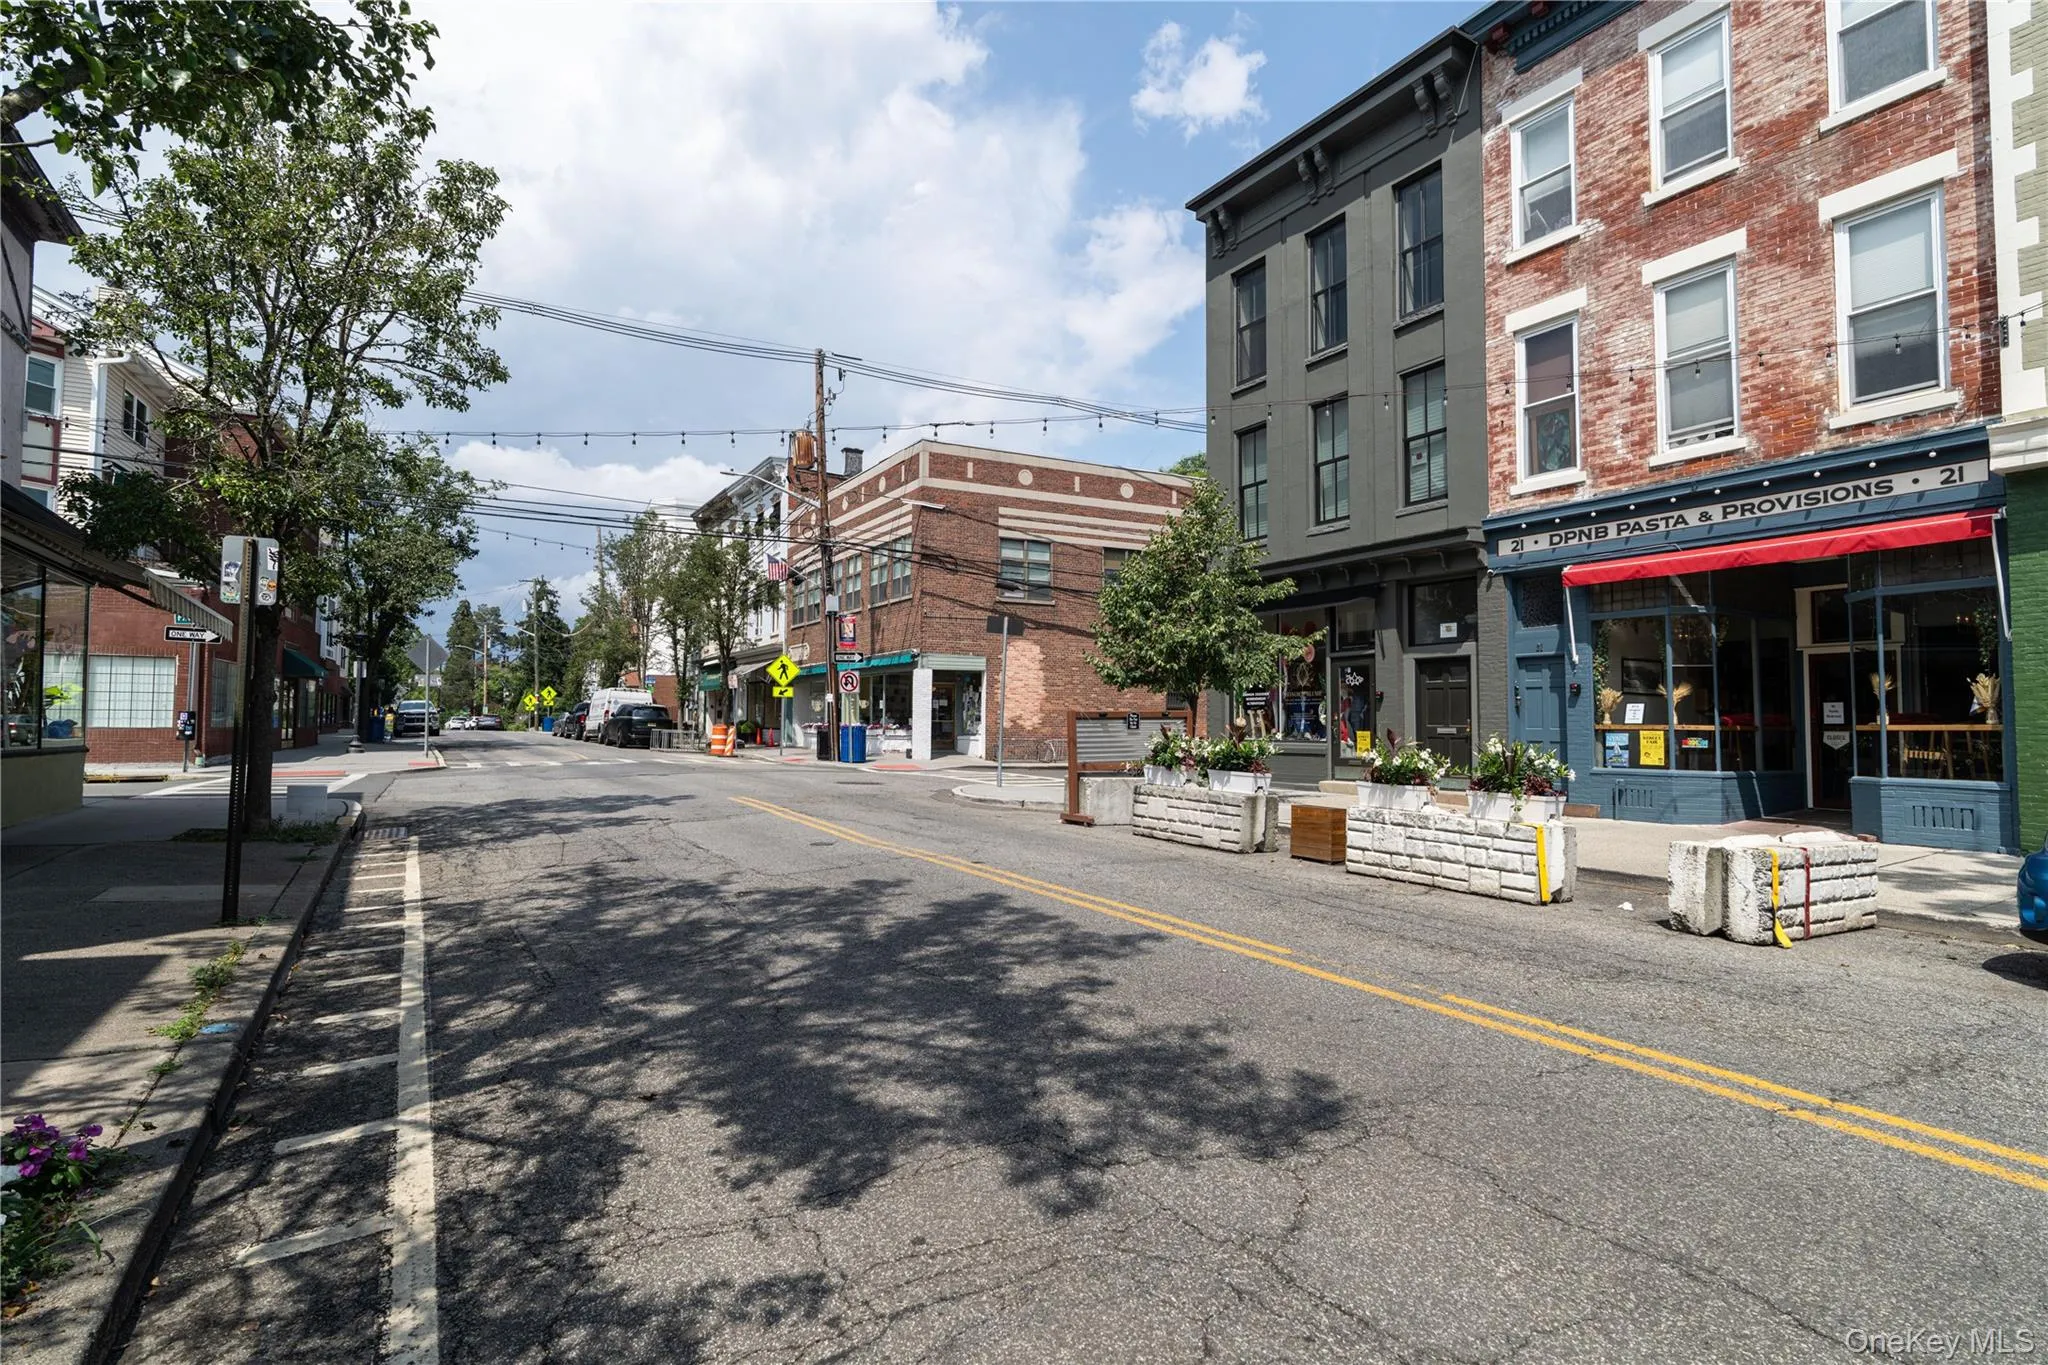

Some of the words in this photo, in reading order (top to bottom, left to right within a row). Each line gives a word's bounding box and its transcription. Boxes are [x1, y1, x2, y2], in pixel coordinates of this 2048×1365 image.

[1510, 538, 1525, 553] 21
[1549, 526, 1609, 547] DPNB
[1616, 514, 1690, 537] PASTA
[1697, 511, 1713, 523] &
[1721, 479, 1894, 520] PROVISIONS
[1939, 465, 1965, 486] 21
[170, 630, 186, 638] ONE
[189, 631, 205, 639] WAY
